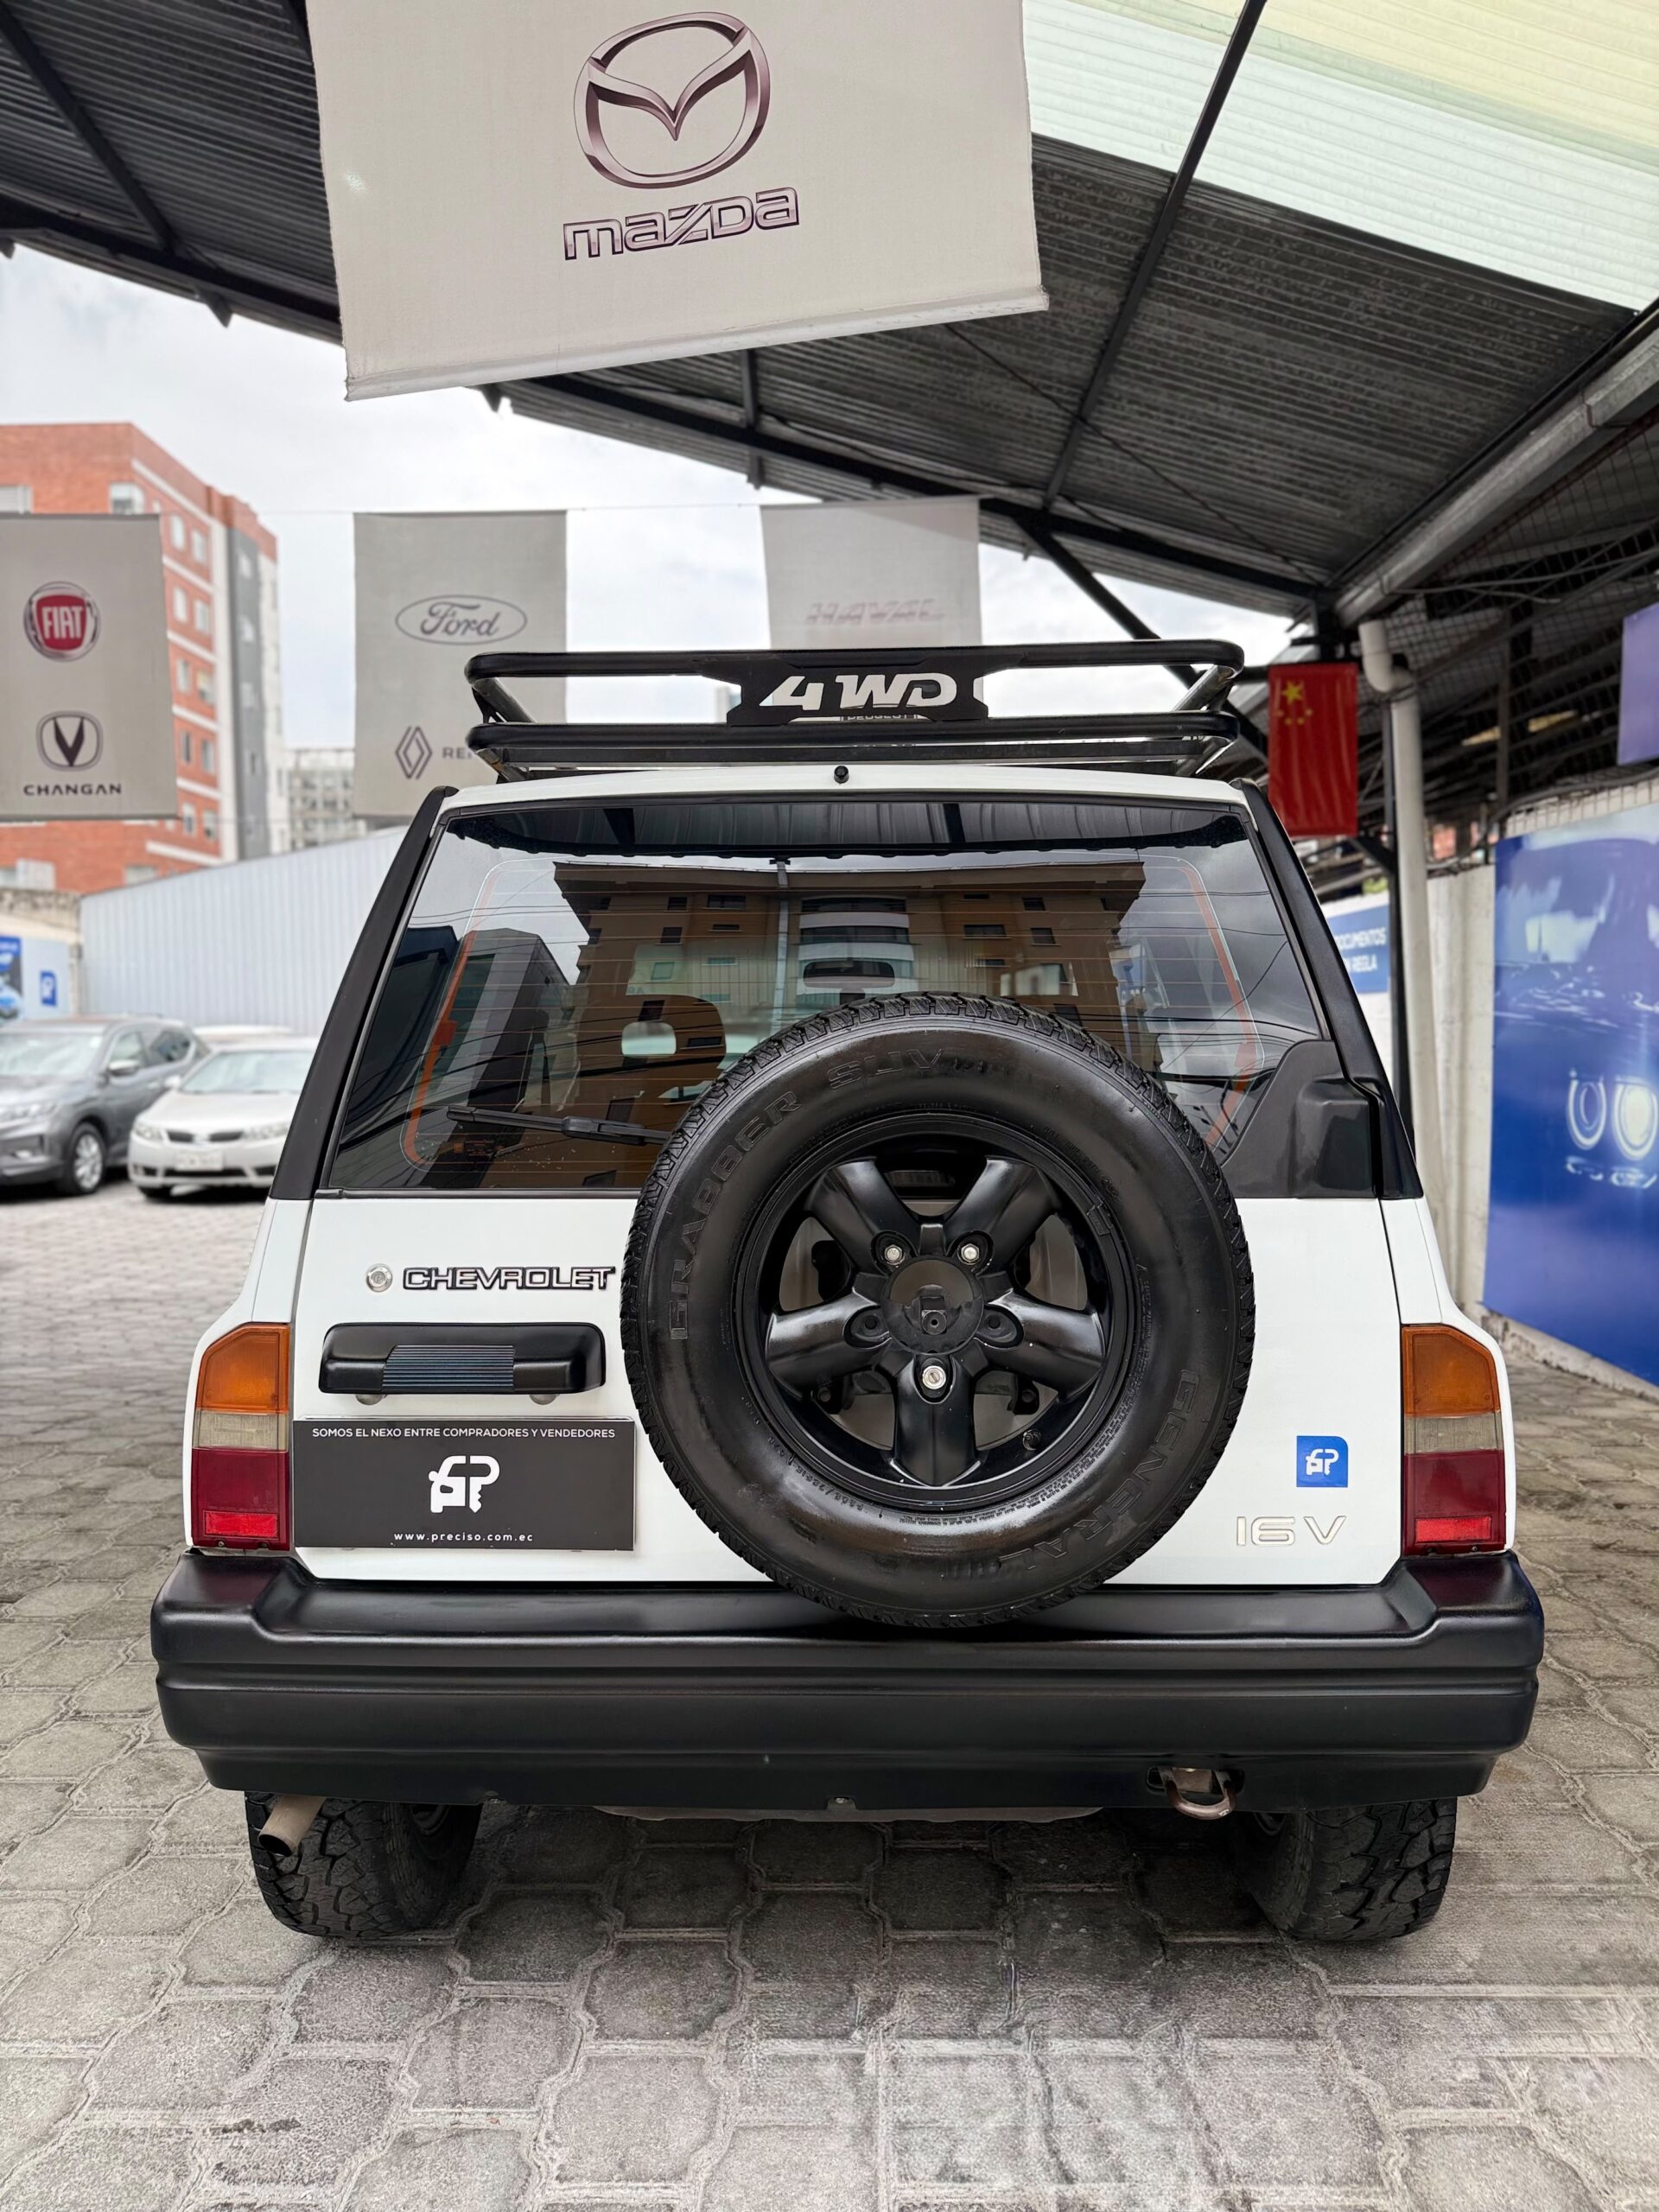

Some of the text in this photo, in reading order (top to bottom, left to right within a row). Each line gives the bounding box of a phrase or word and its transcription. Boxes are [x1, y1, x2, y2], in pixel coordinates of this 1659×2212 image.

[563, 187, 799, 261] mazda
[41, 606, 83, 639] FIAT
[421, 601, 501, 636] Ford
[23, 784, 122, 797] CHANGAN
[670, 1090, 803, 1340] GRABBER
[403, 1266, 616, 1291] CHEVROLET
[312, 1428, 615, 1438] SOMOS EL NEXO ENTRE COMPRADORES Y VENDEDORES
[999, 1369, 1199, 1570] GENERAL
[394, 1532, 533, 1542] www.preciso.com.ec
